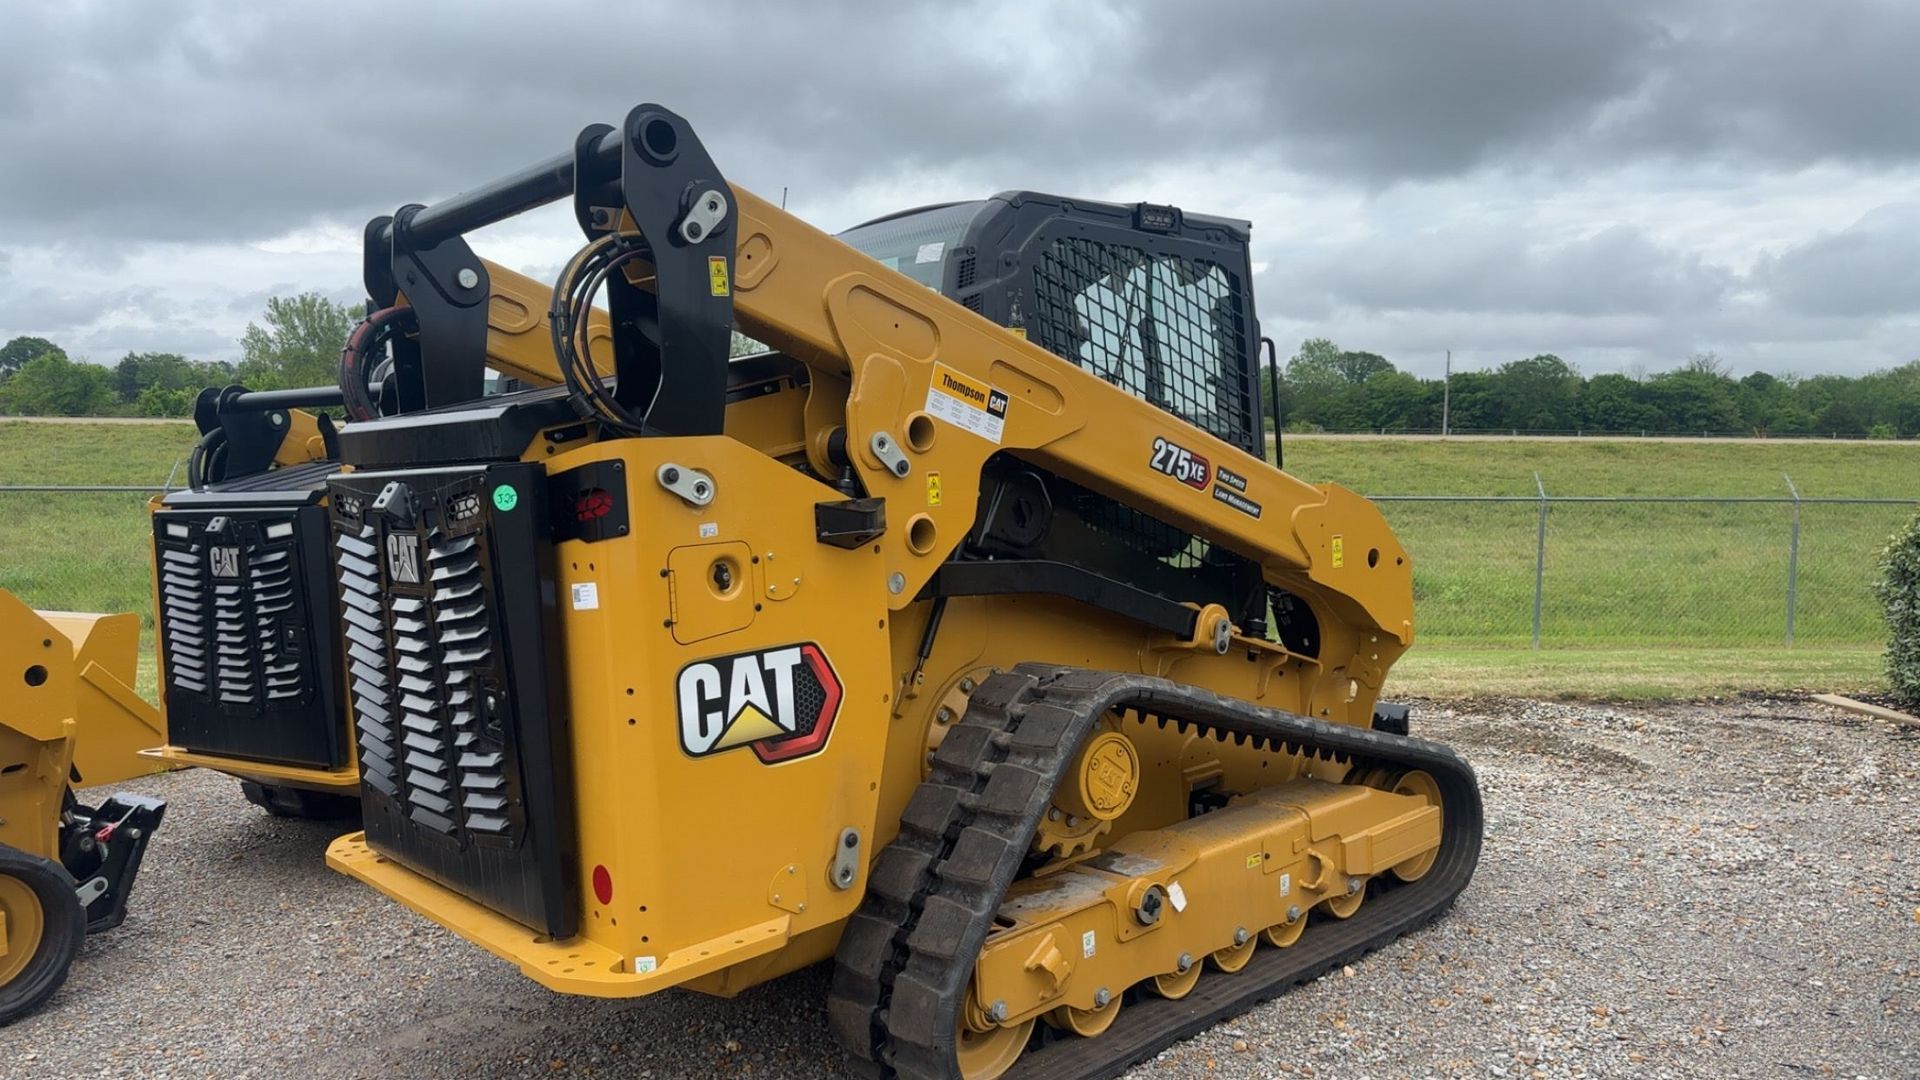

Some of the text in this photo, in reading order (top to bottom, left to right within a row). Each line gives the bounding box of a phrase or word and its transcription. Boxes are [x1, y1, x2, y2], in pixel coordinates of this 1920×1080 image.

[942, 373, 986, 404] Thompson
[989, 395, 1007, 413] CAT
[210, 546, 240, 577] CAT
[386, 534, 420, 583] CAT
[679, 646, 802, 754] CAT
